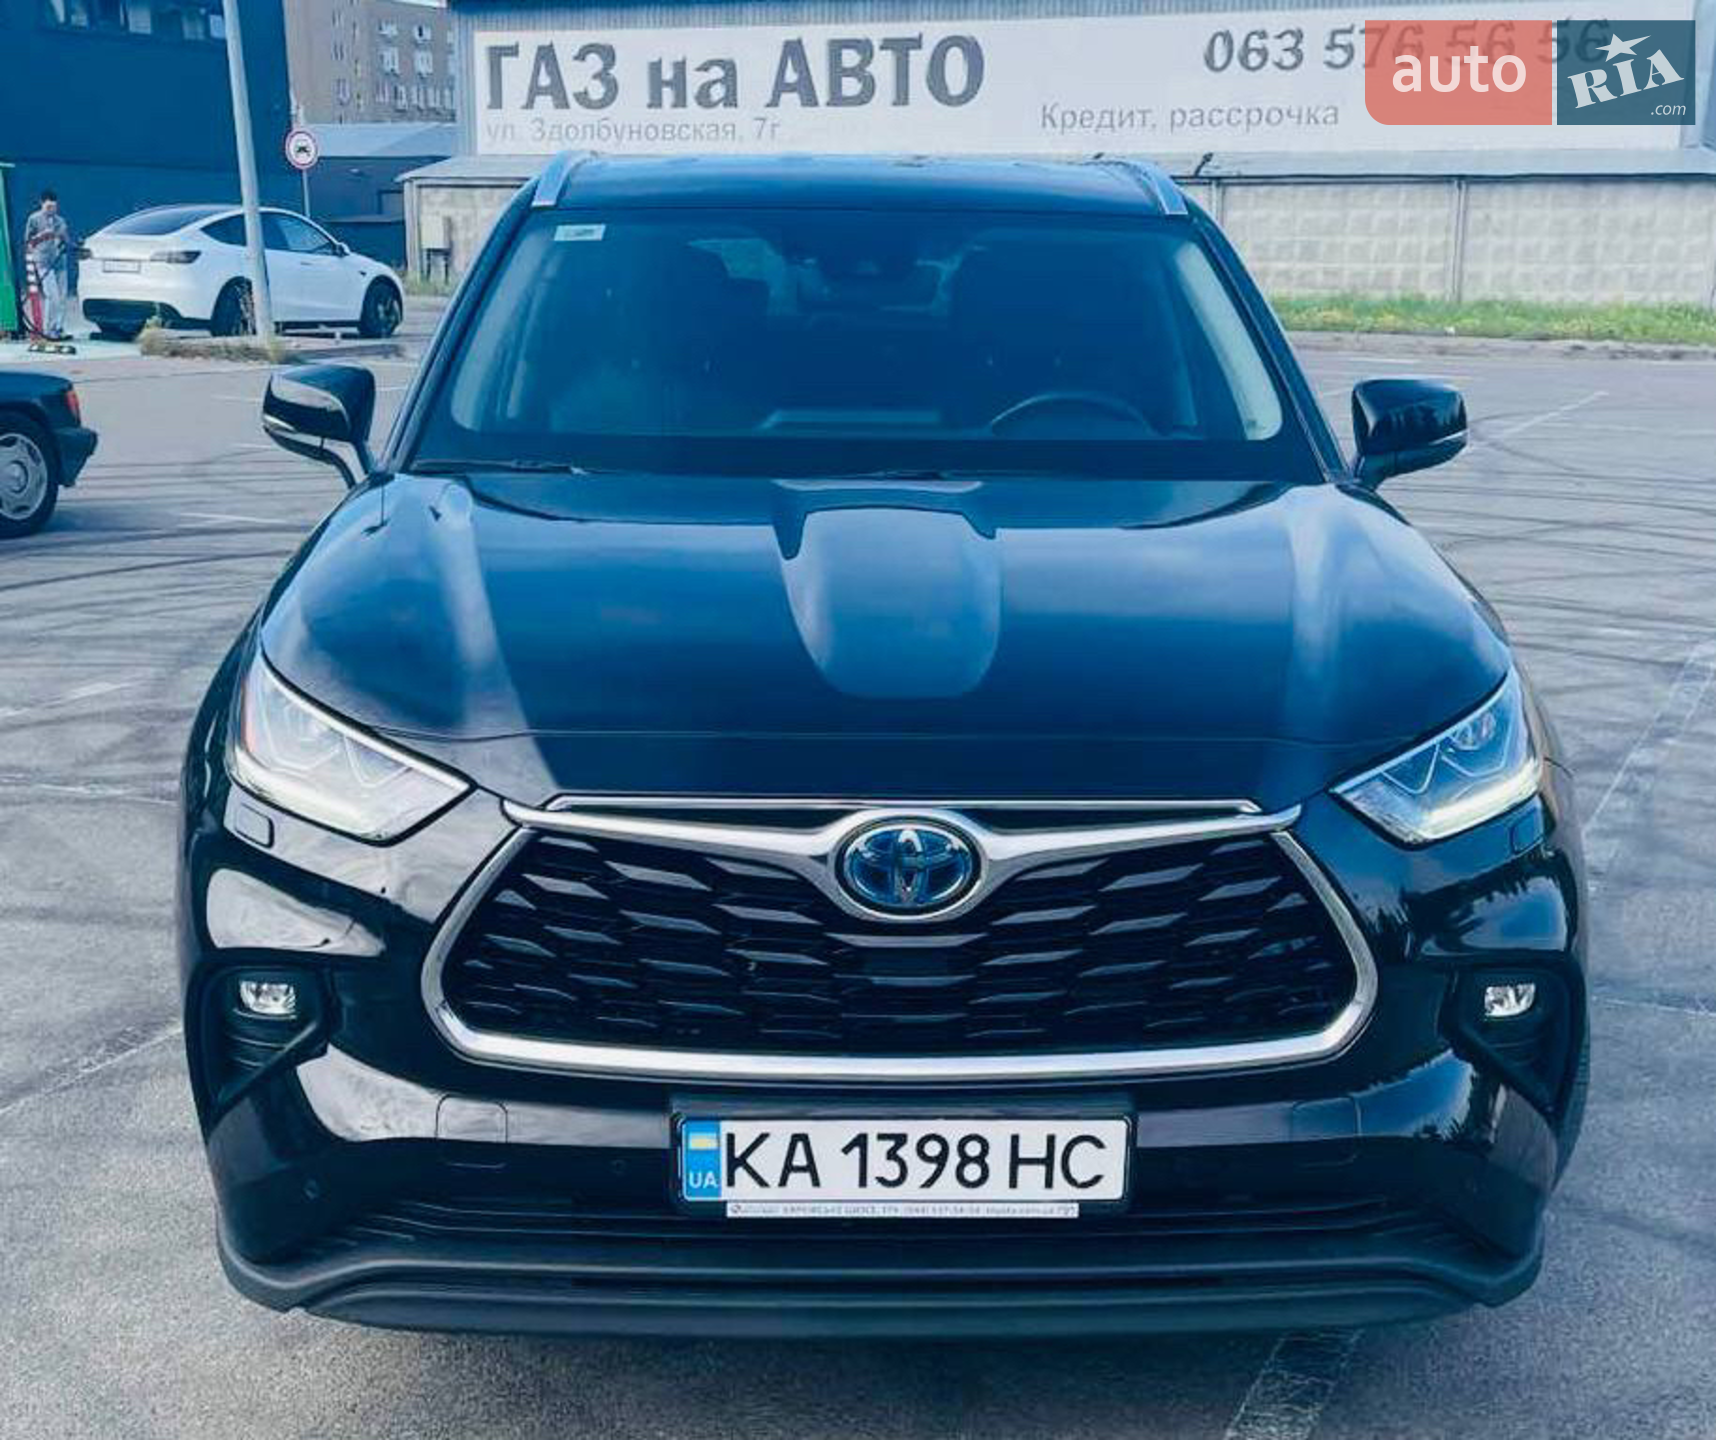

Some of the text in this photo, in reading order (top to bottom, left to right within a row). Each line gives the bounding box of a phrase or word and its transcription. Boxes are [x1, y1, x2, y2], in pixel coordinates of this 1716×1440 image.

[486, 34, 985, 110] ГАЗ на АВТО
[1203, 27, 1305, 72] 063
[1324, 22, 1425, 70] 576
[1041, 102, 1340, 131] Кредит, рассрочка
[688, 1171, 718, 1189] UA
[726, 1133, 1107, 1189] KA 1398 HC
